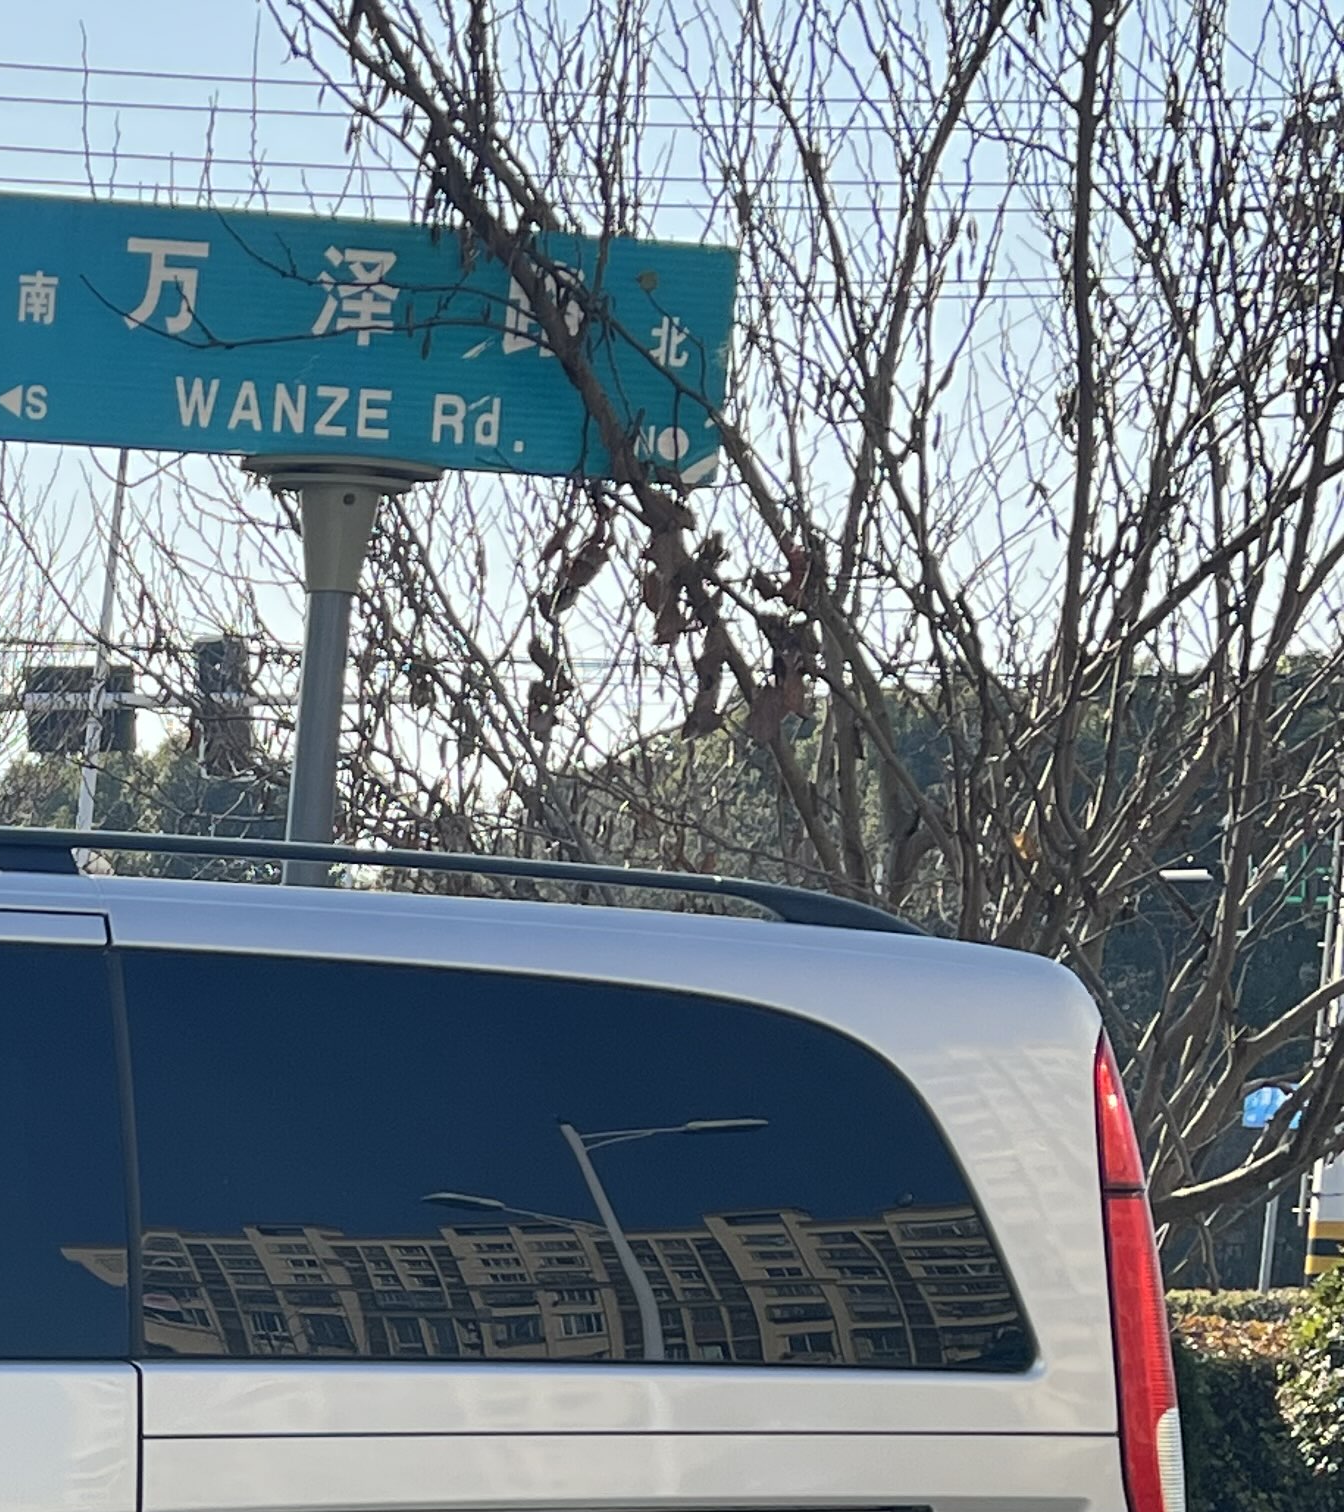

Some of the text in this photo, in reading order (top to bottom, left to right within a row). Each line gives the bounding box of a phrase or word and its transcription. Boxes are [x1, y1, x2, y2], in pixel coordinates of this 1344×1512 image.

[18, 270, 58, 325] 南
[649, 315, 691, 368] 北
[25, 384, 49, 420] S
[174, 375, 525, 453] WANZE Rd.
